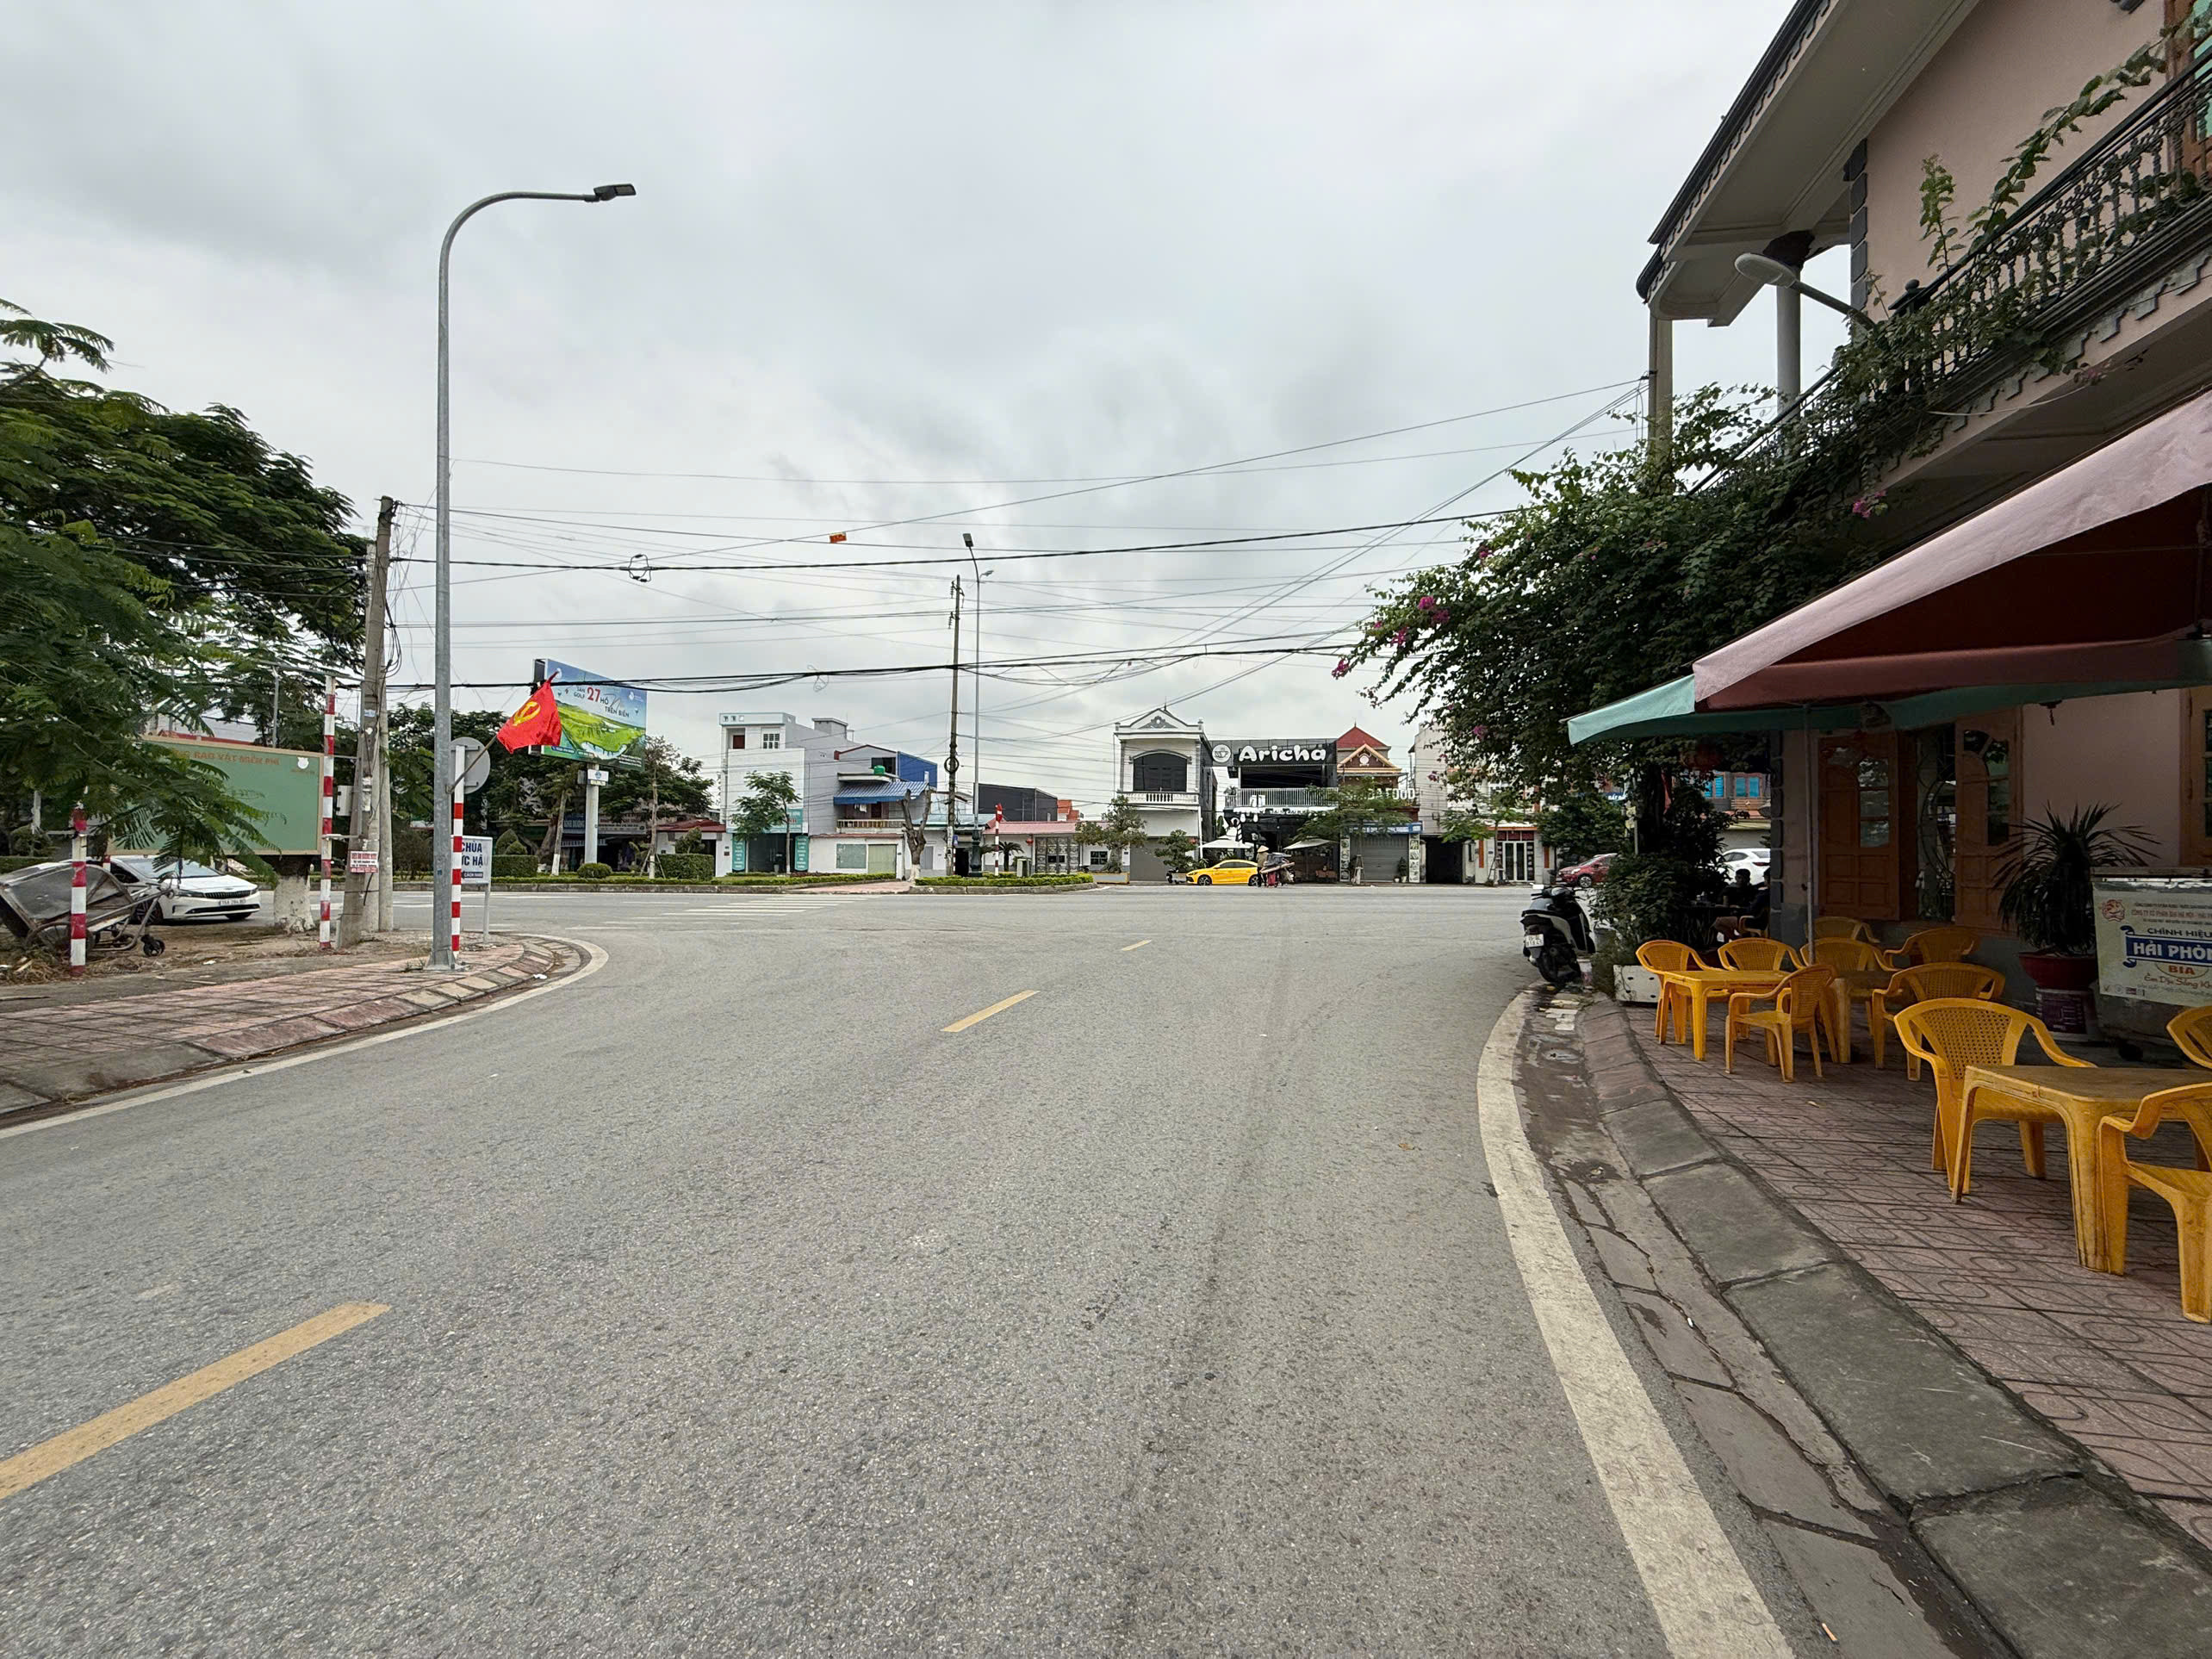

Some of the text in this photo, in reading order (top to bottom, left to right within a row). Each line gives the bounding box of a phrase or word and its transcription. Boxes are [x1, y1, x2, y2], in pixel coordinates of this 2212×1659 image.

[587, 687, 600, 702] 27
[1239, 744, 1327, 762] Aricha
[462, 840, 482, 852] CHÙA
[2147, 928, 2183, 936] CHÍNH
[2134, 940, 2162, 956] HẢI
[2169, 966, 2196, 975] BIA
